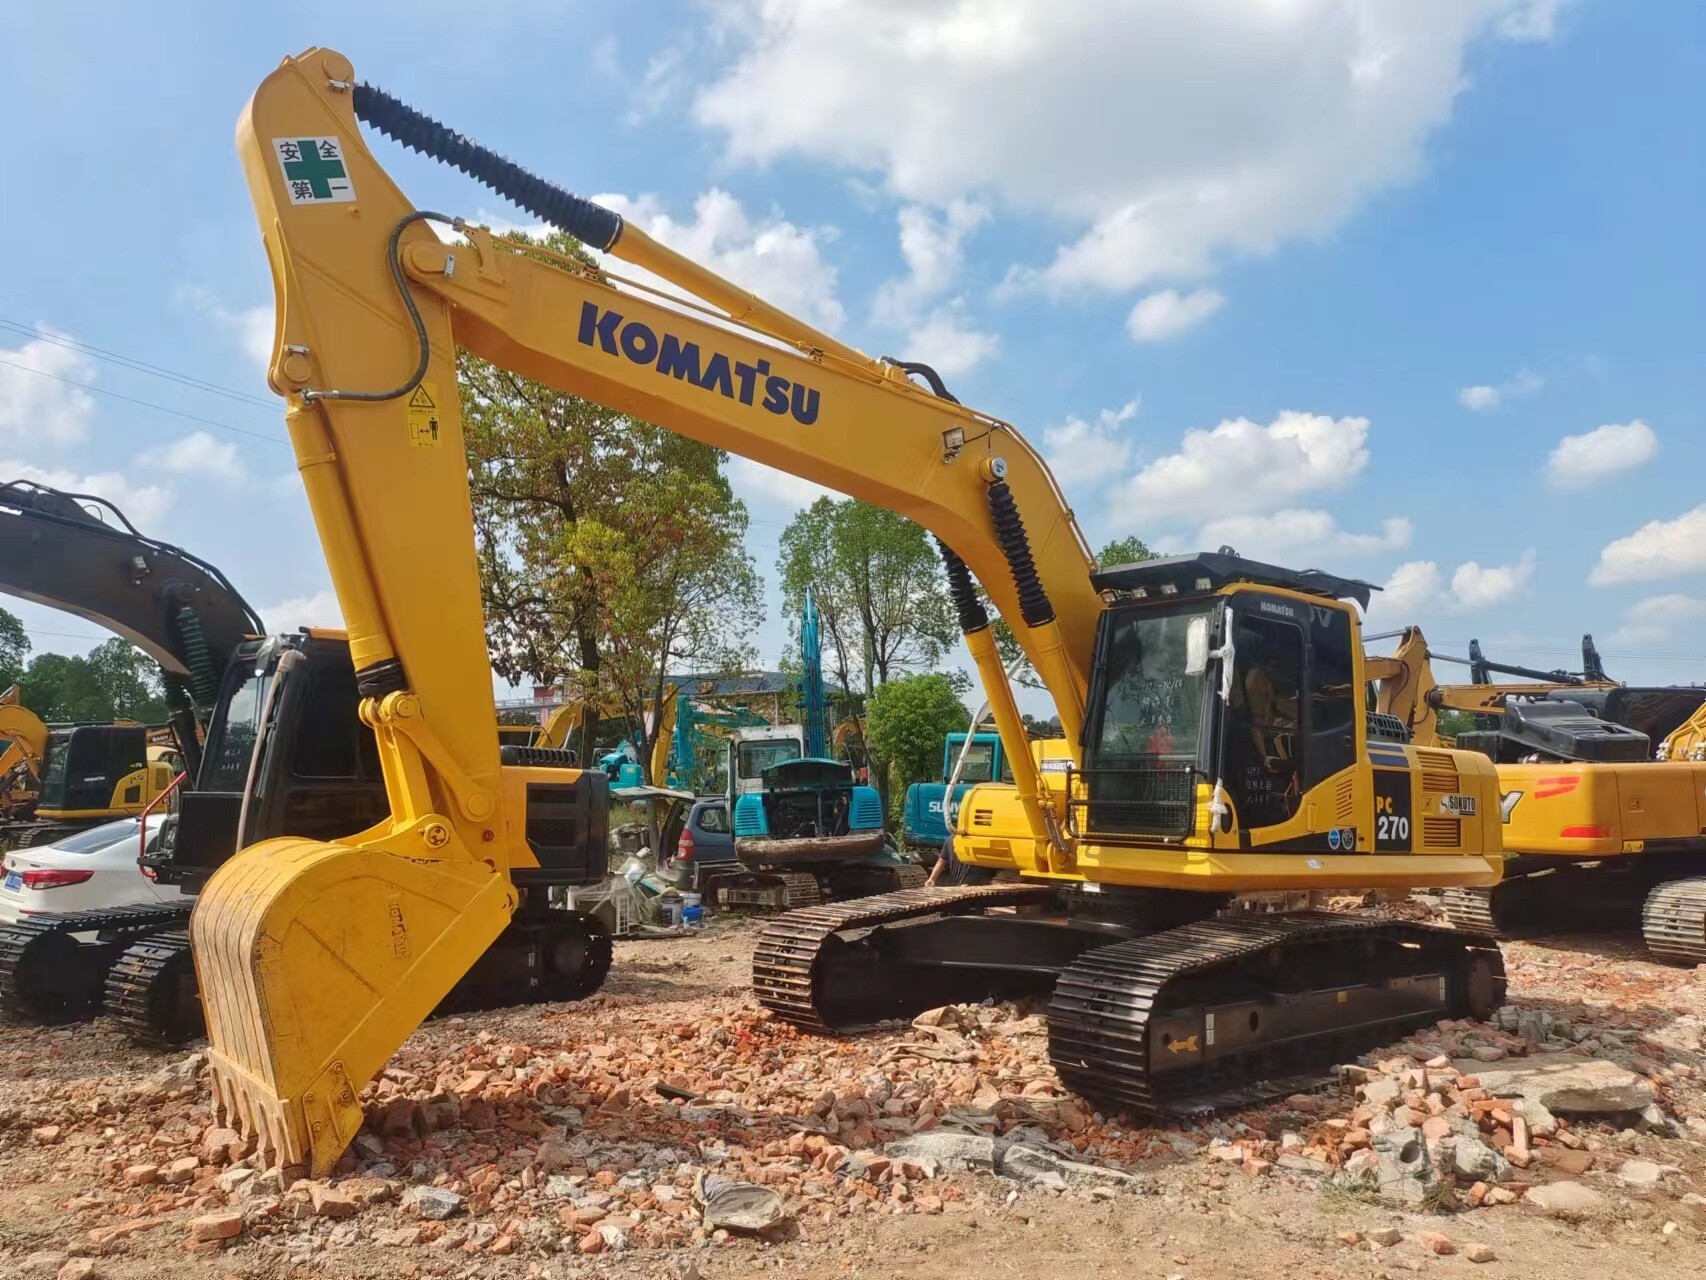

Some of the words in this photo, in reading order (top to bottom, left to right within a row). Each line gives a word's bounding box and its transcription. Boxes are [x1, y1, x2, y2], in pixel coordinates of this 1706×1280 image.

[578, 301, 820, 426] KOMATSU
[1261, 602, 1294, 617] KOMATSU
[1376, 796, 1393, 814] PC
[1449, 795, 1476, 811] SOKUTO
[1378, 815, 1409, 840] 270
